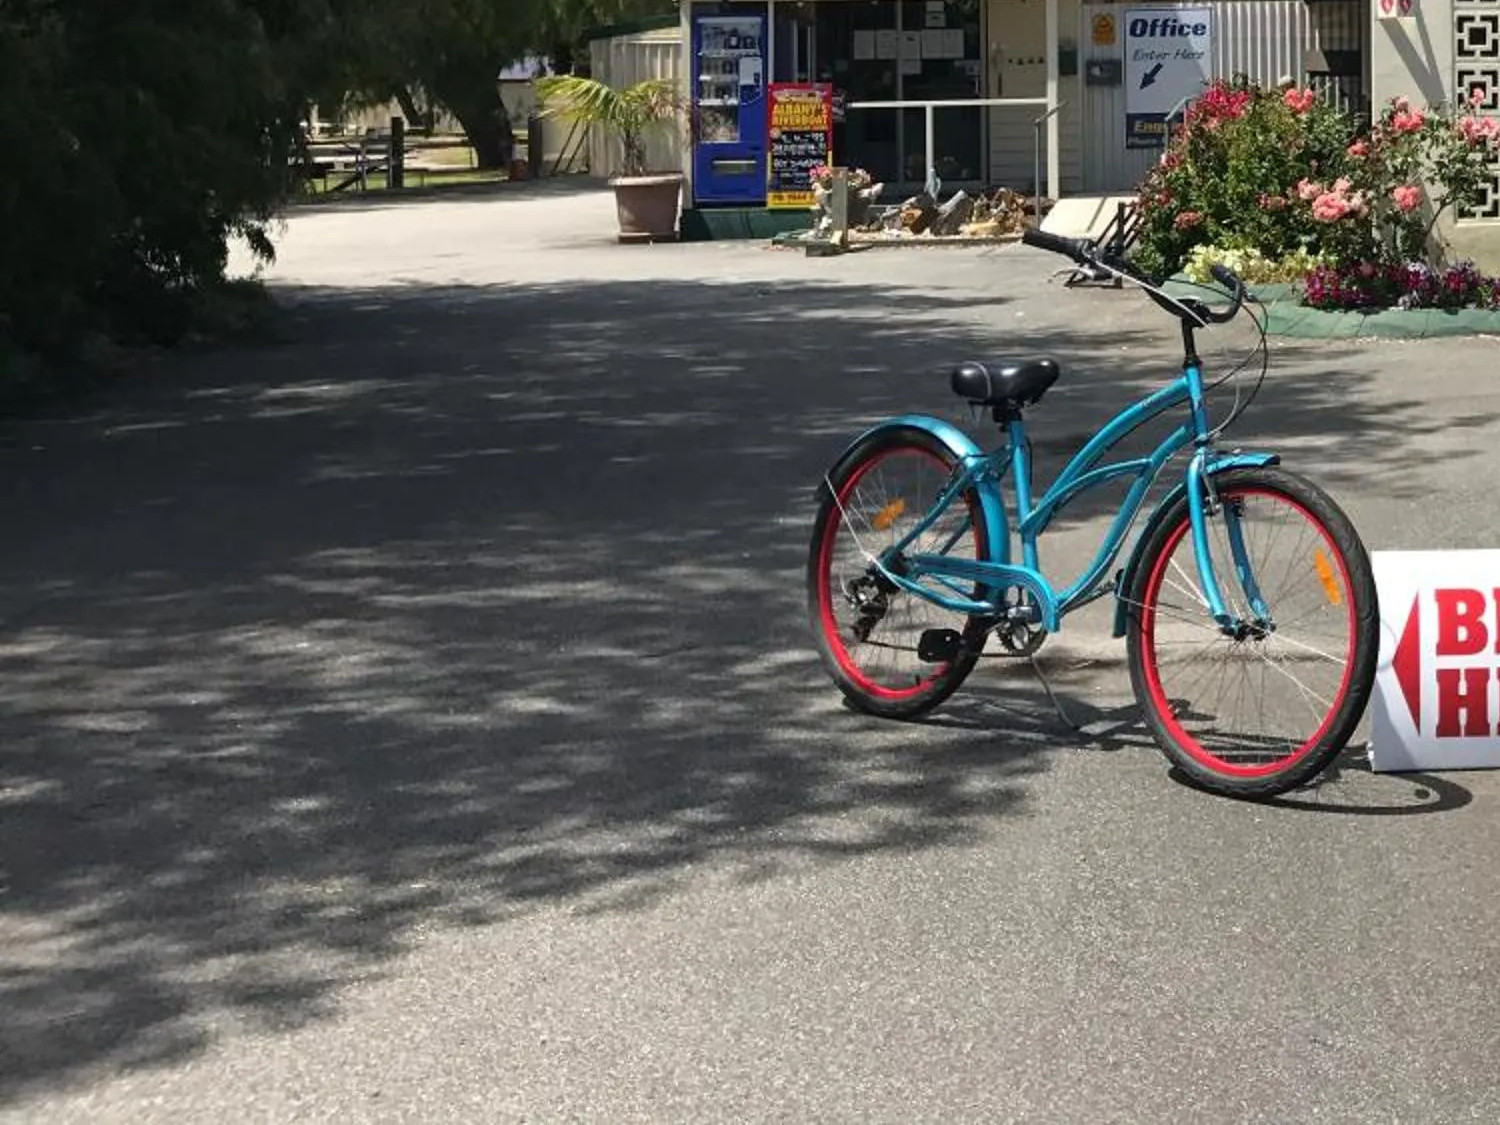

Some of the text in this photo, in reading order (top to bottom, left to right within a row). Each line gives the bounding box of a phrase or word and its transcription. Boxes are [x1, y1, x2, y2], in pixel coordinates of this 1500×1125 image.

[1129, 18, 1207, 38] Office
[1132, 48, 1205, 61] Enter Here
